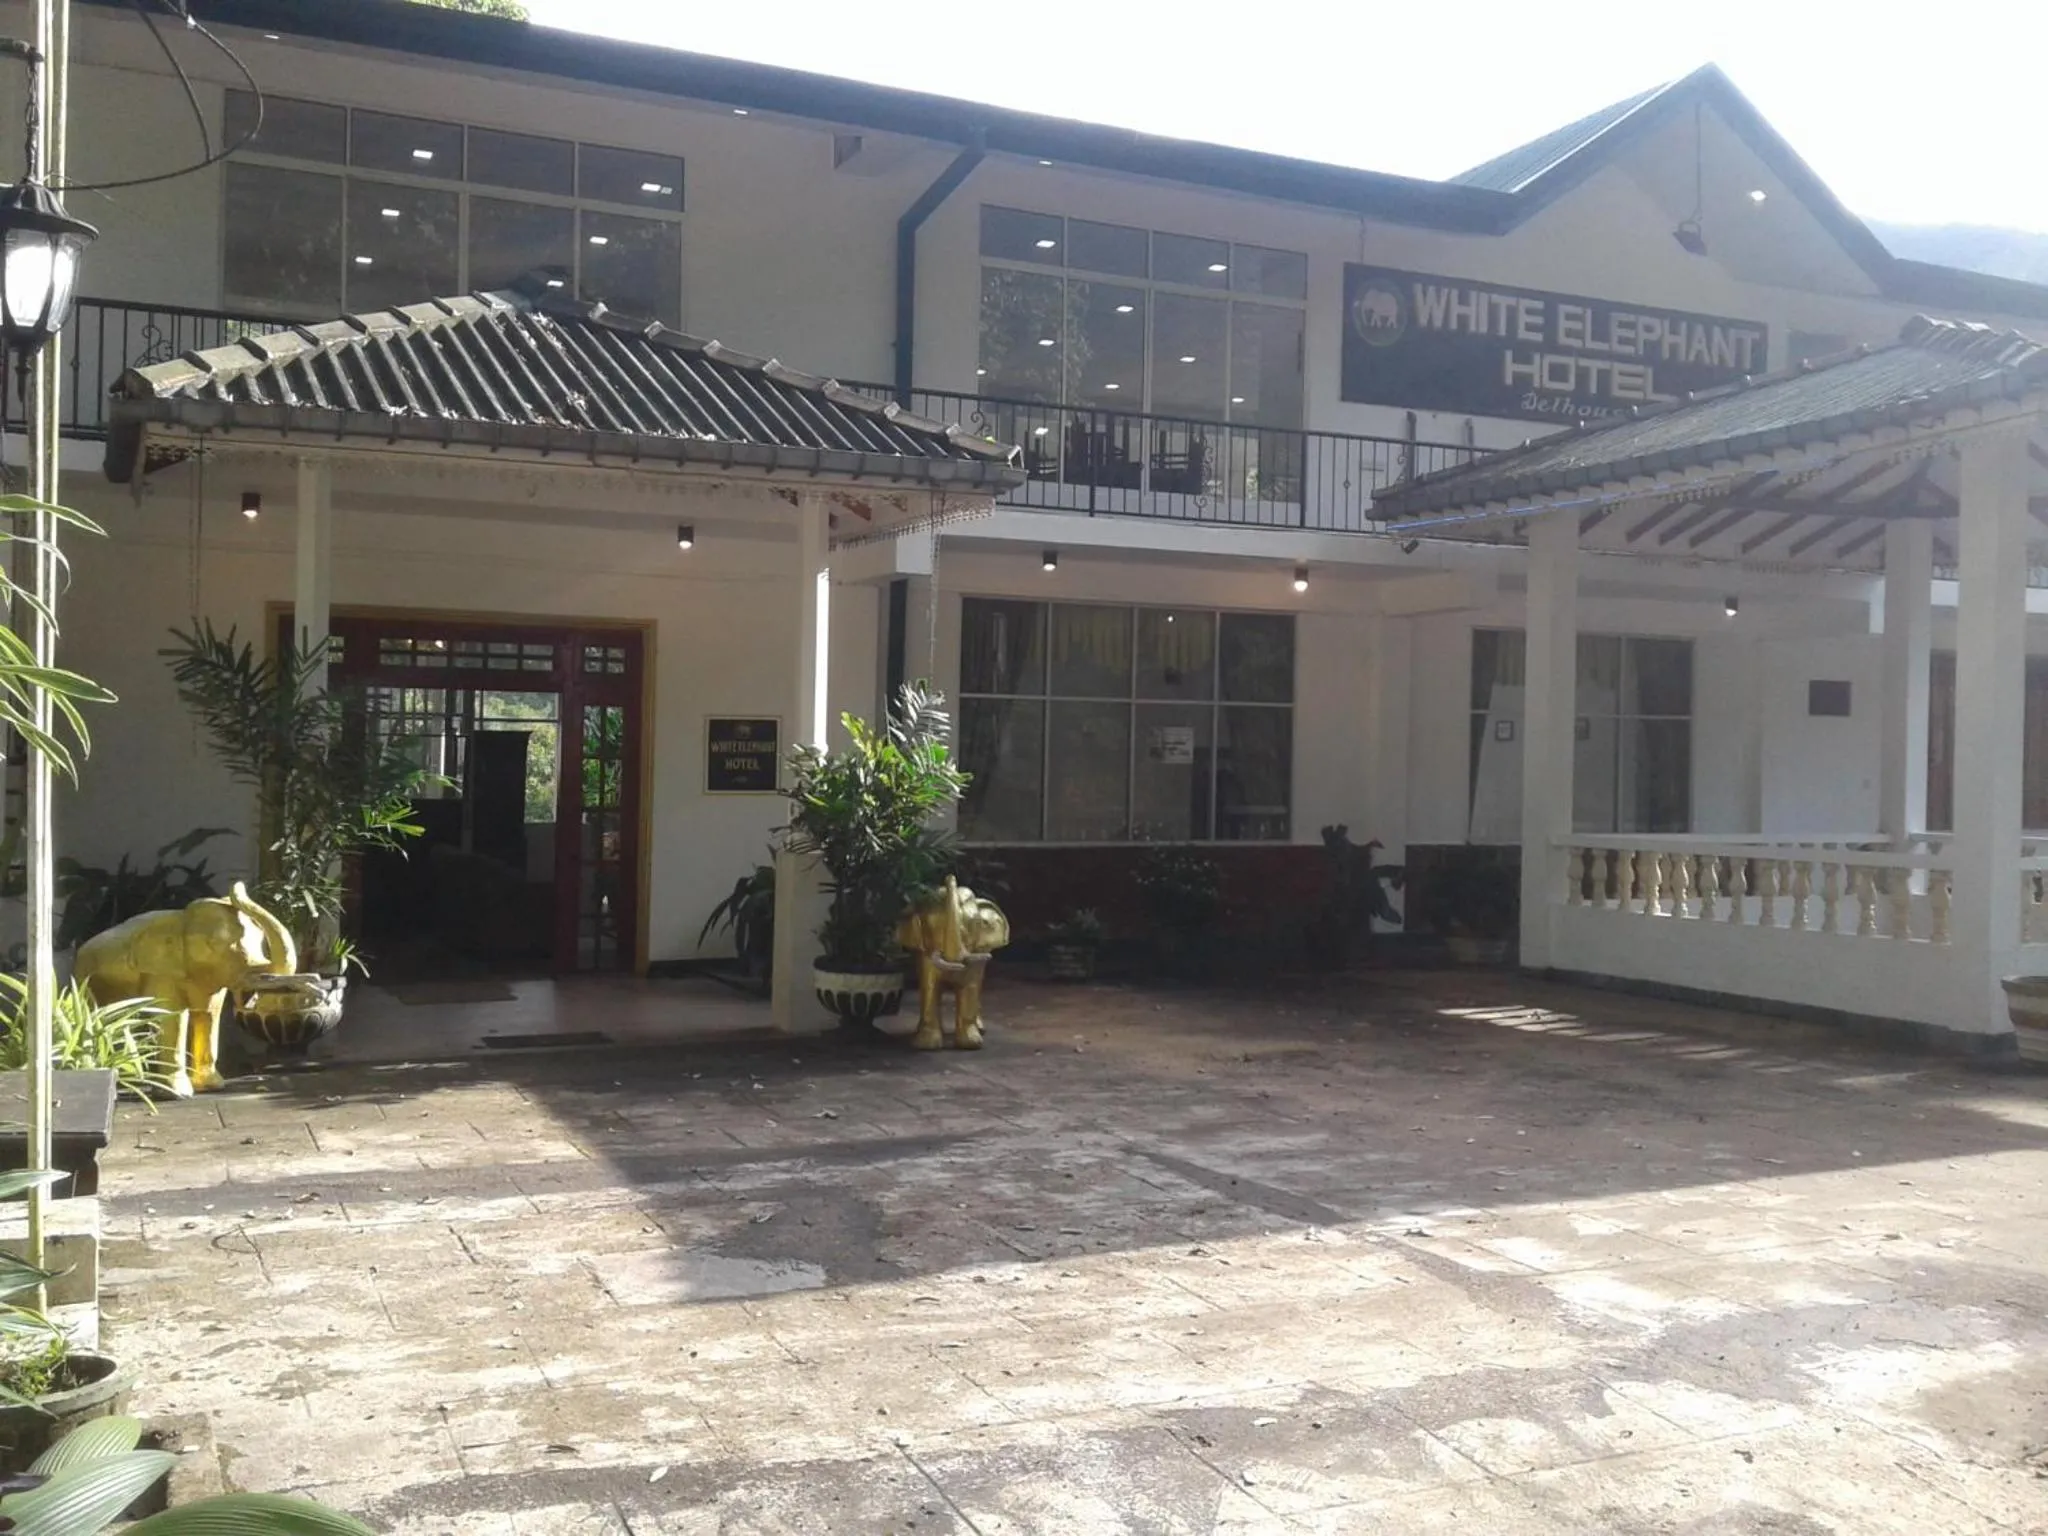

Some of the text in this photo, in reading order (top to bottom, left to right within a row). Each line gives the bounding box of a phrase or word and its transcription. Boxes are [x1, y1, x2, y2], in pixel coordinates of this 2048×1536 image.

[1413, 283, 1760, 370] WHITE ELEPHANT
[1504, 350, 1676, 403] HOTEL
[725, 757, 760, 771] HOTEL
